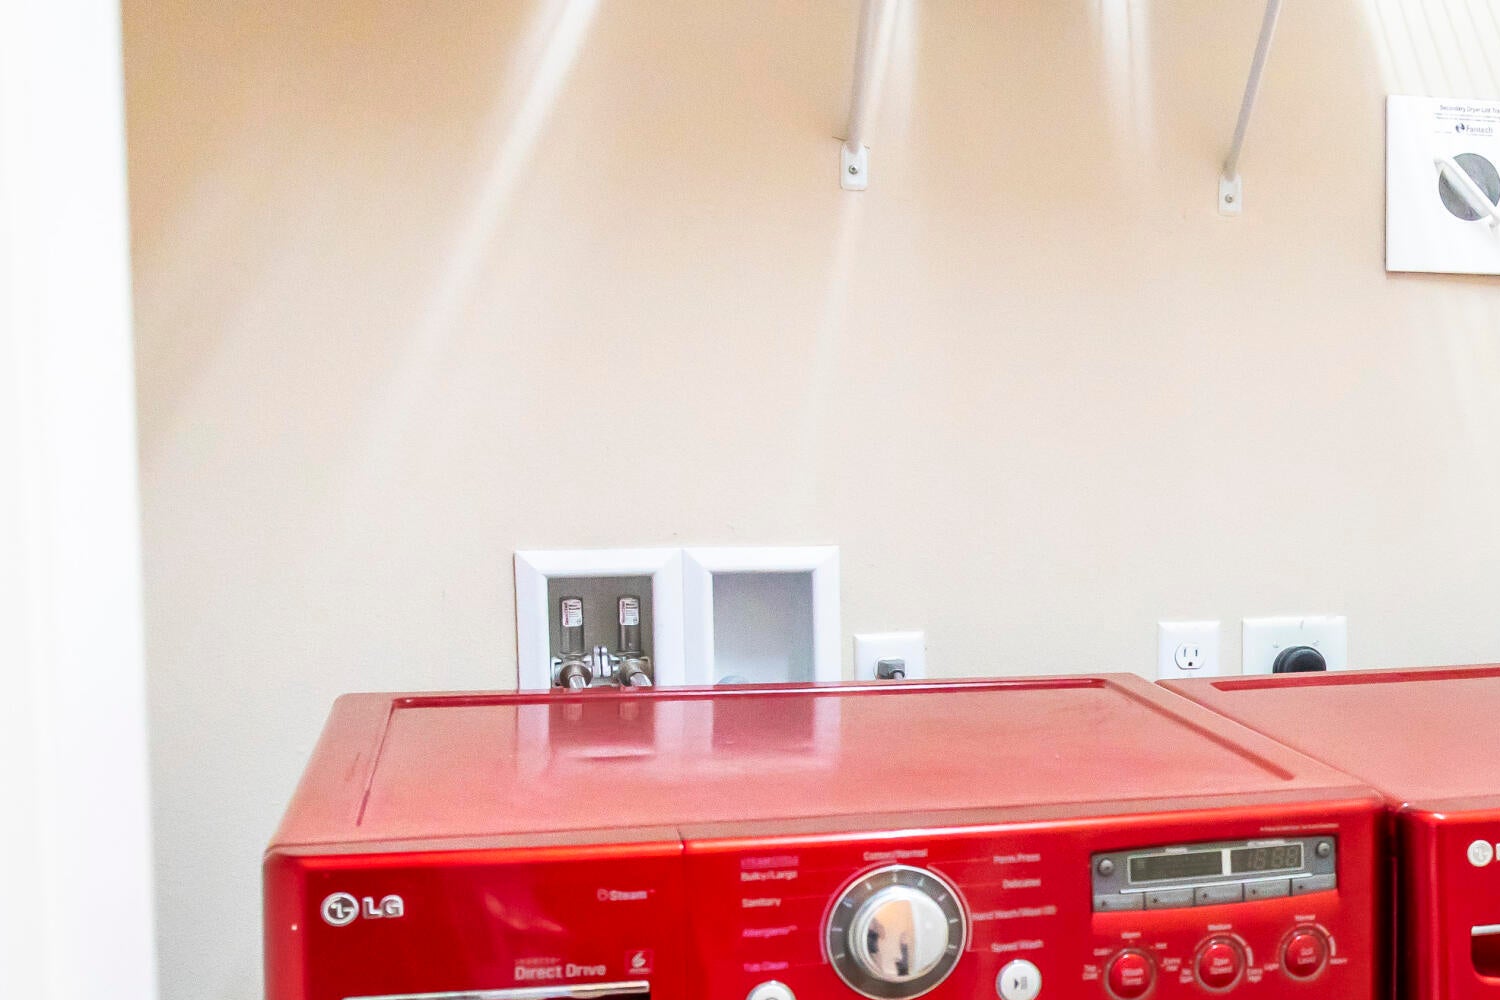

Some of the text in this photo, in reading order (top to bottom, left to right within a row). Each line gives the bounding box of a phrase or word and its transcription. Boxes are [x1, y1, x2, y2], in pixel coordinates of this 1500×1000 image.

[609, 890, 648, 901] Steam
[362, 894, 404, 919] LG
[514, 963, 606, 980] Direct Drive
